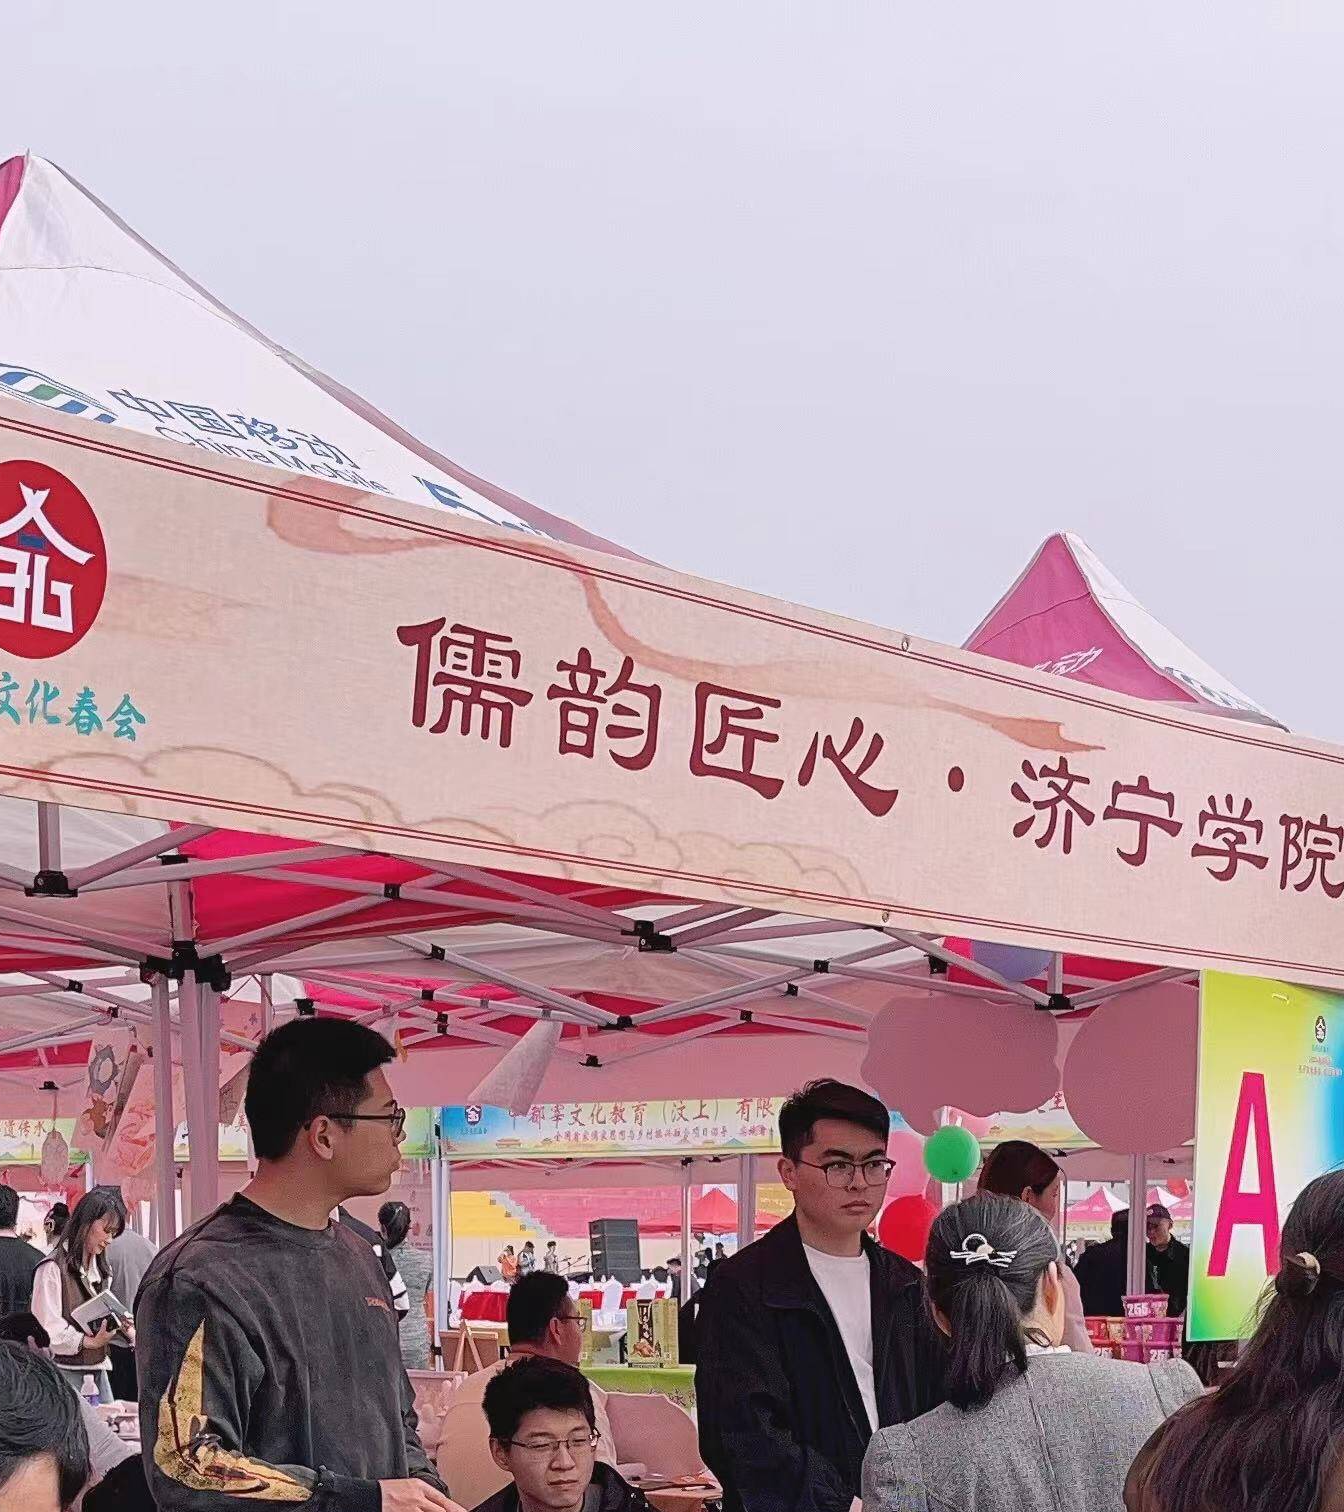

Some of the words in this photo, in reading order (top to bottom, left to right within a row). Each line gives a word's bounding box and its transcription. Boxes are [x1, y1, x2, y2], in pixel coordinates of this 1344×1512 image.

[107, 388, 361, 470] 中国移动
[155, 425, 272, 464] China
[1207, 1071, 1279, 1277] A
